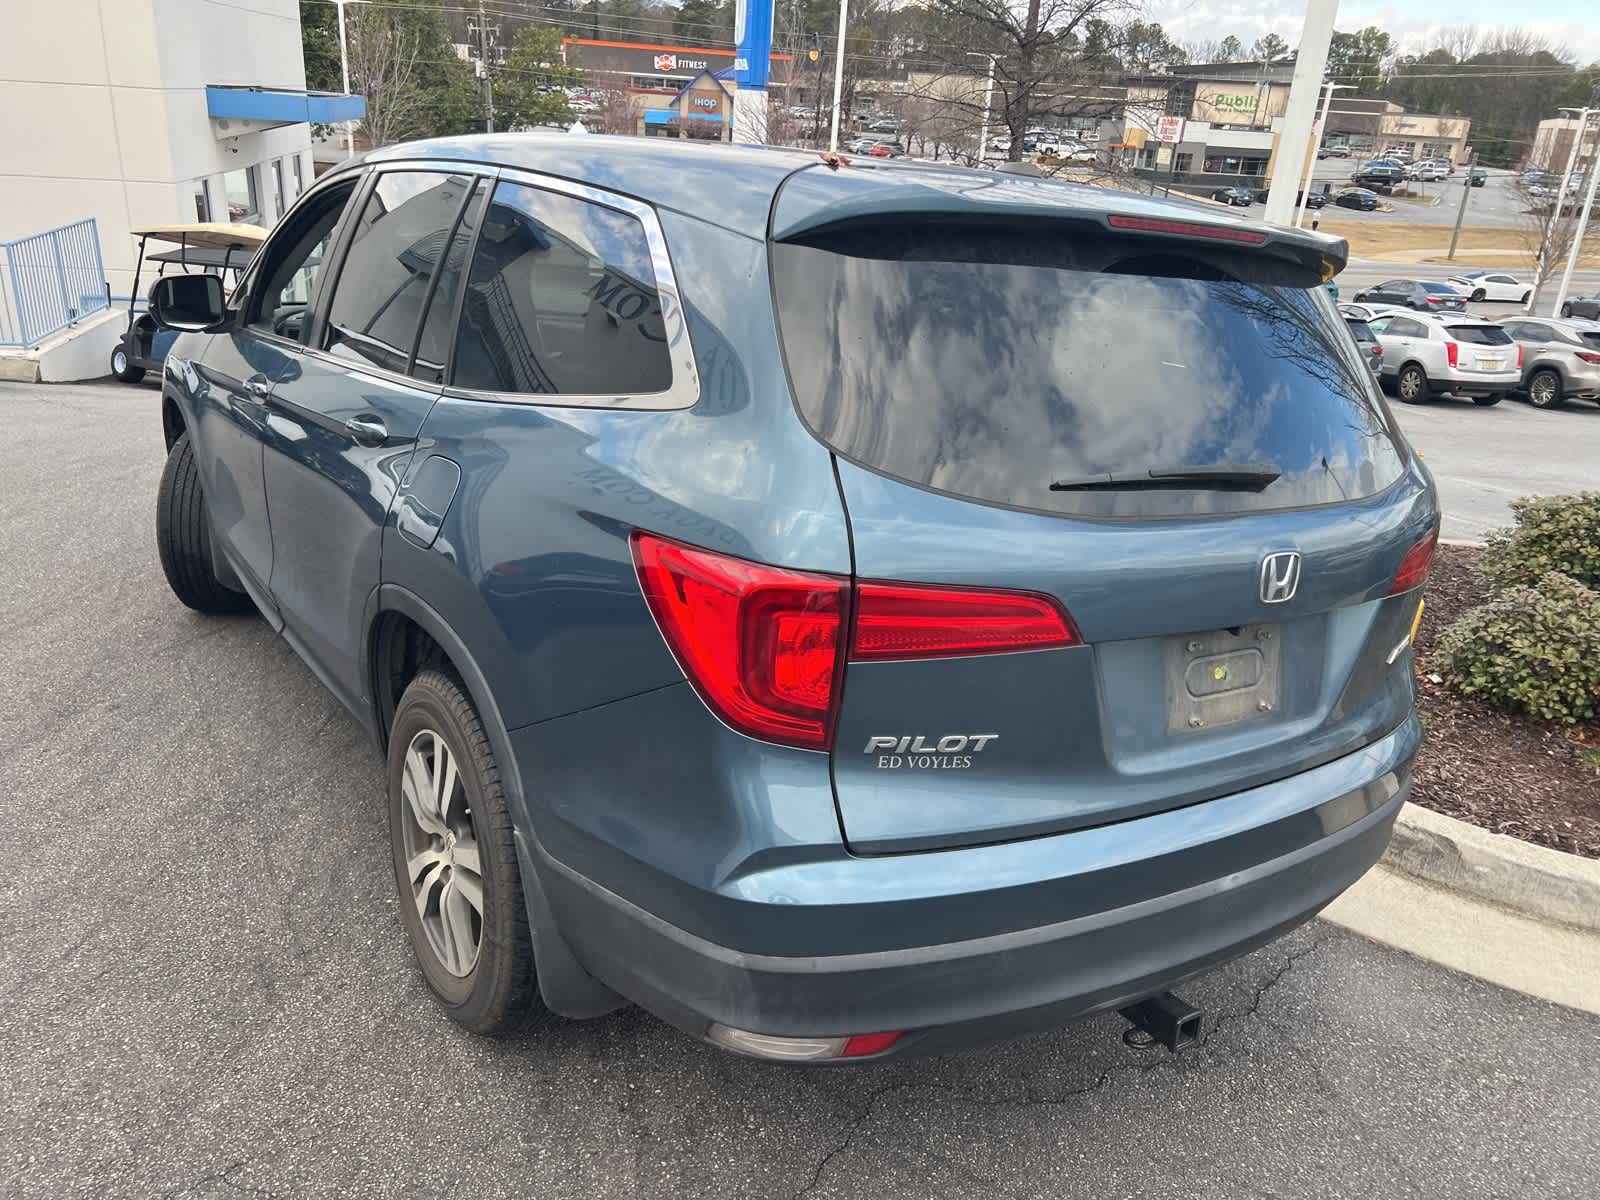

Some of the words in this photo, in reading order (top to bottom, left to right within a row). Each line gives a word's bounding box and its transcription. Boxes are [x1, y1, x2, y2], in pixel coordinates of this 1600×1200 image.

[678, 59, 707, 69] FITNESS
[864, 734, 999, 754] PILOT
[878, 755, 902, 769] ED
[908, 755, 972, 769] VOYLES
